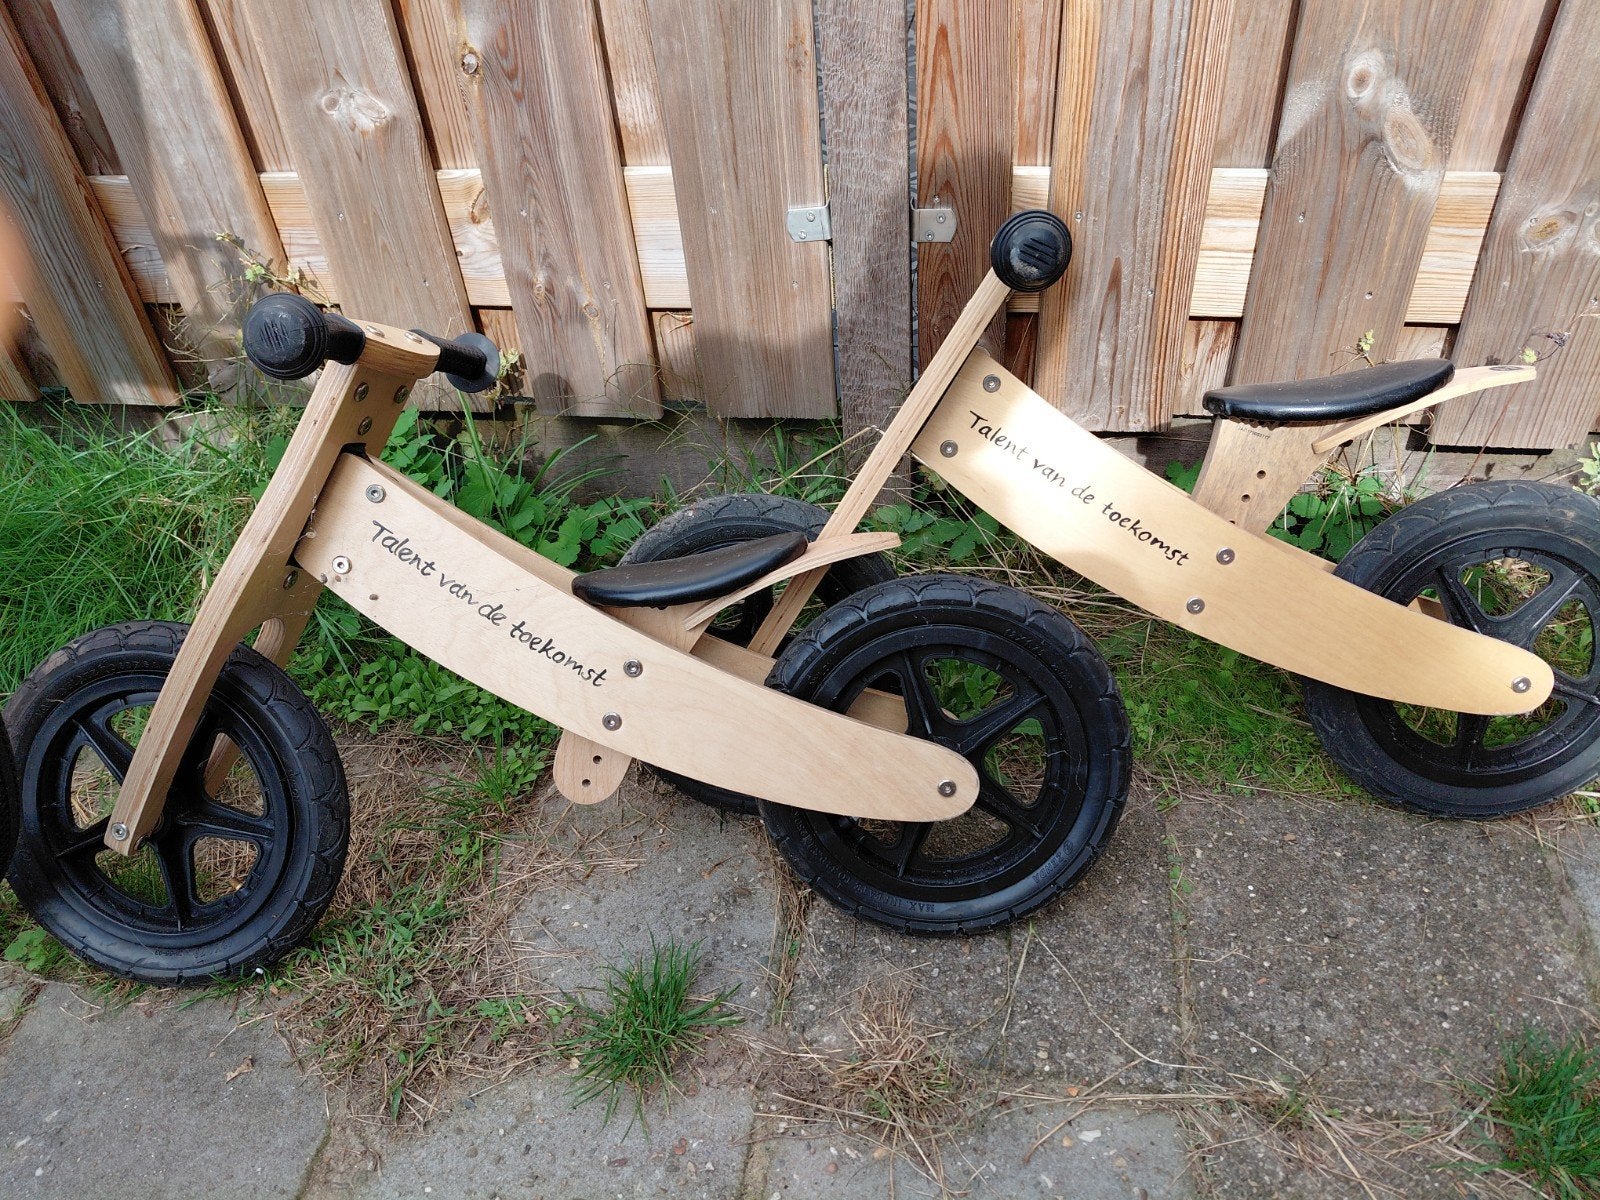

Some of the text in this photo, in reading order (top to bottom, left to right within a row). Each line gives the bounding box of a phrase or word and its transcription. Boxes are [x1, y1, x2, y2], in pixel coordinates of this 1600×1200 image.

[969, 410, 1189, 566] Talent van de toekomst
[371, 520, 607, 686] Talent van de toekomst
